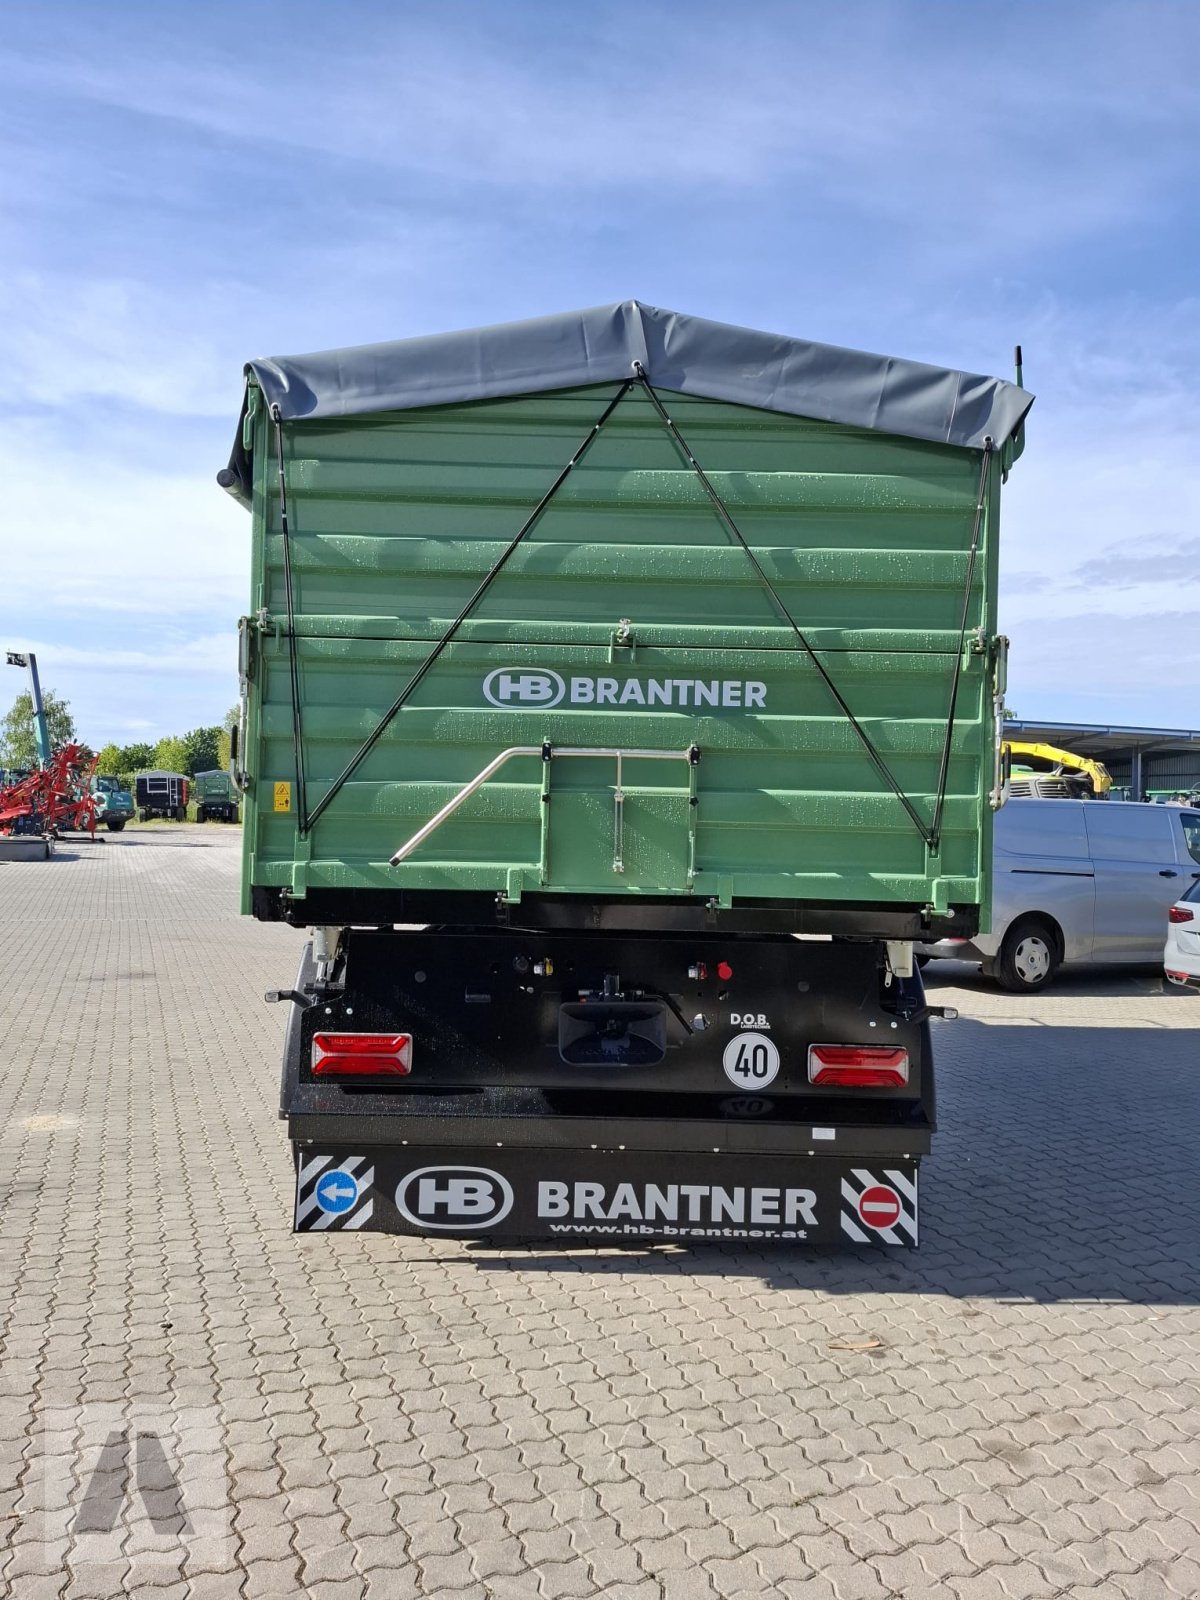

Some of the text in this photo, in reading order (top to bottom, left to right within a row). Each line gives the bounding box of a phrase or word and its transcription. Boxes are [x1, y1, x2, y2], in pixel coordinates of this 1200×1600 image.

[499, 675, 767, 708] HB BRANTNER
[730, 1013, 770, 1025] D.O.B.
[734, 1043, 768, 1078] 40
[418, 1178, 819, 1225] HB BRANTNER
[549, 1224, 807, 1239] www.hb-brantner.at
